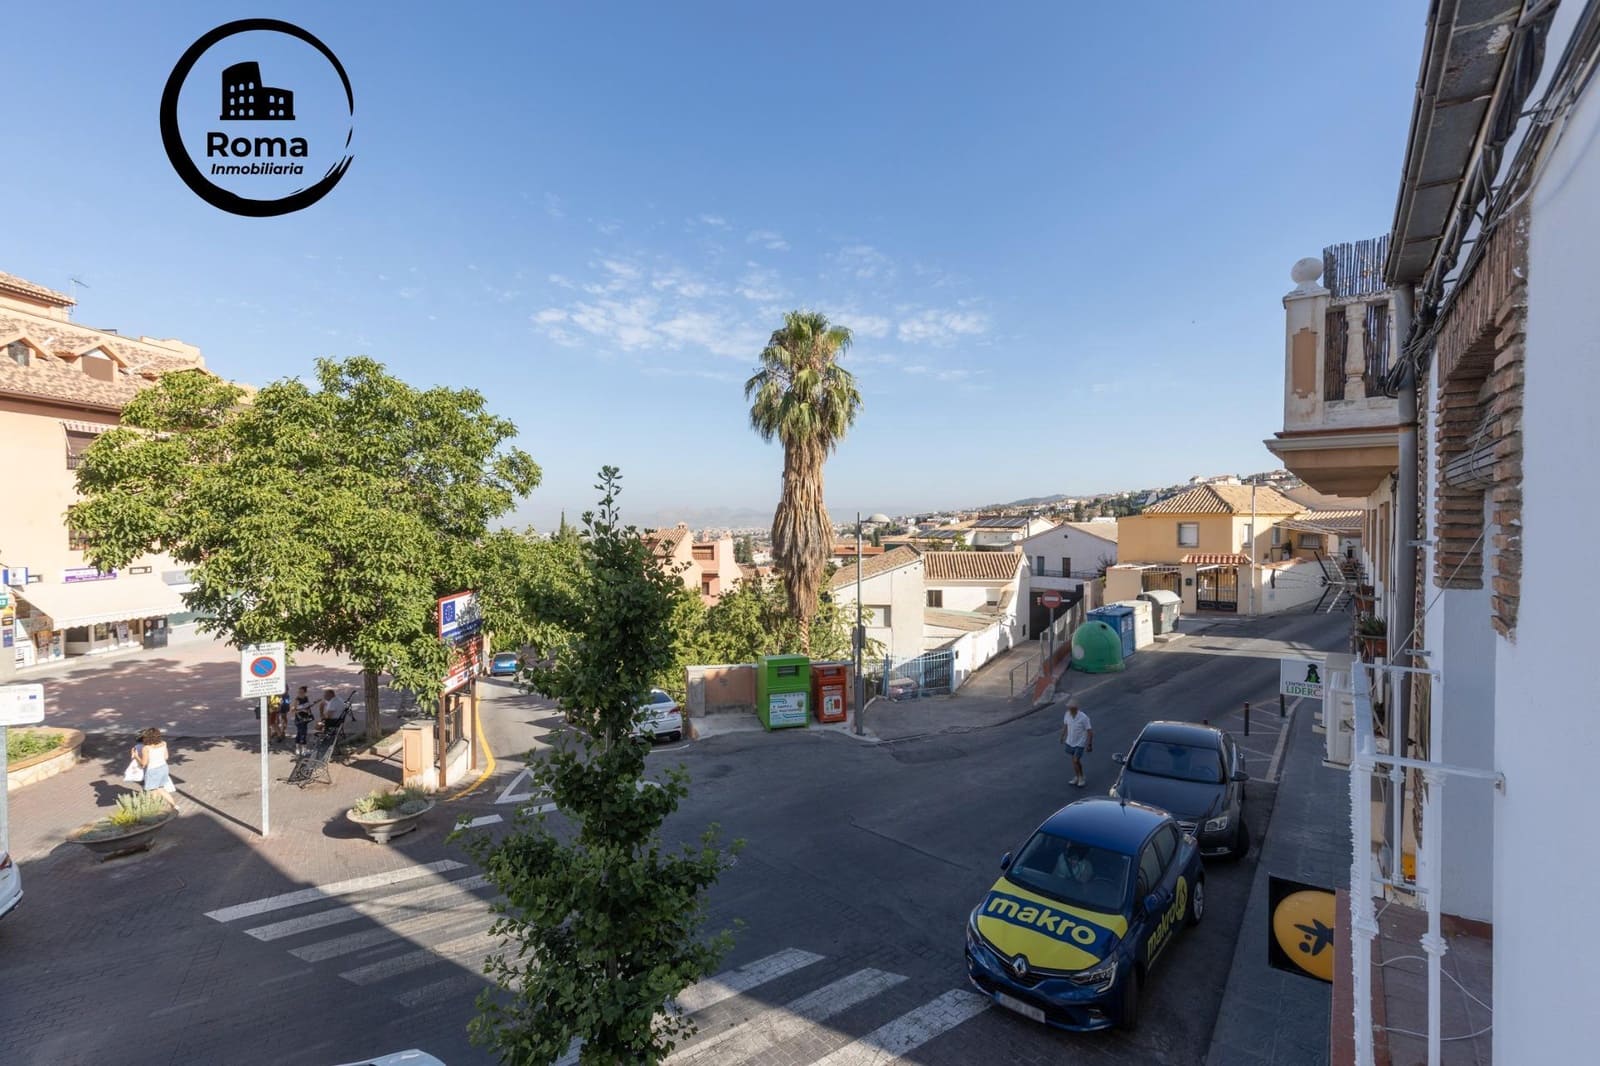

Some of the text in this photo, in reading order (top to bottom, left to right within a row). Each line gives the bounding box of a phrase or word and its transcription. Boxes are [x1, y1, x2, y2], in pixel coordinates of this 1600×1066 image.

[1286, 685, 1323, 697] LIDERC
[987, 897, 1096, 945] makro
[1147, 903, 1176, 961] makro
